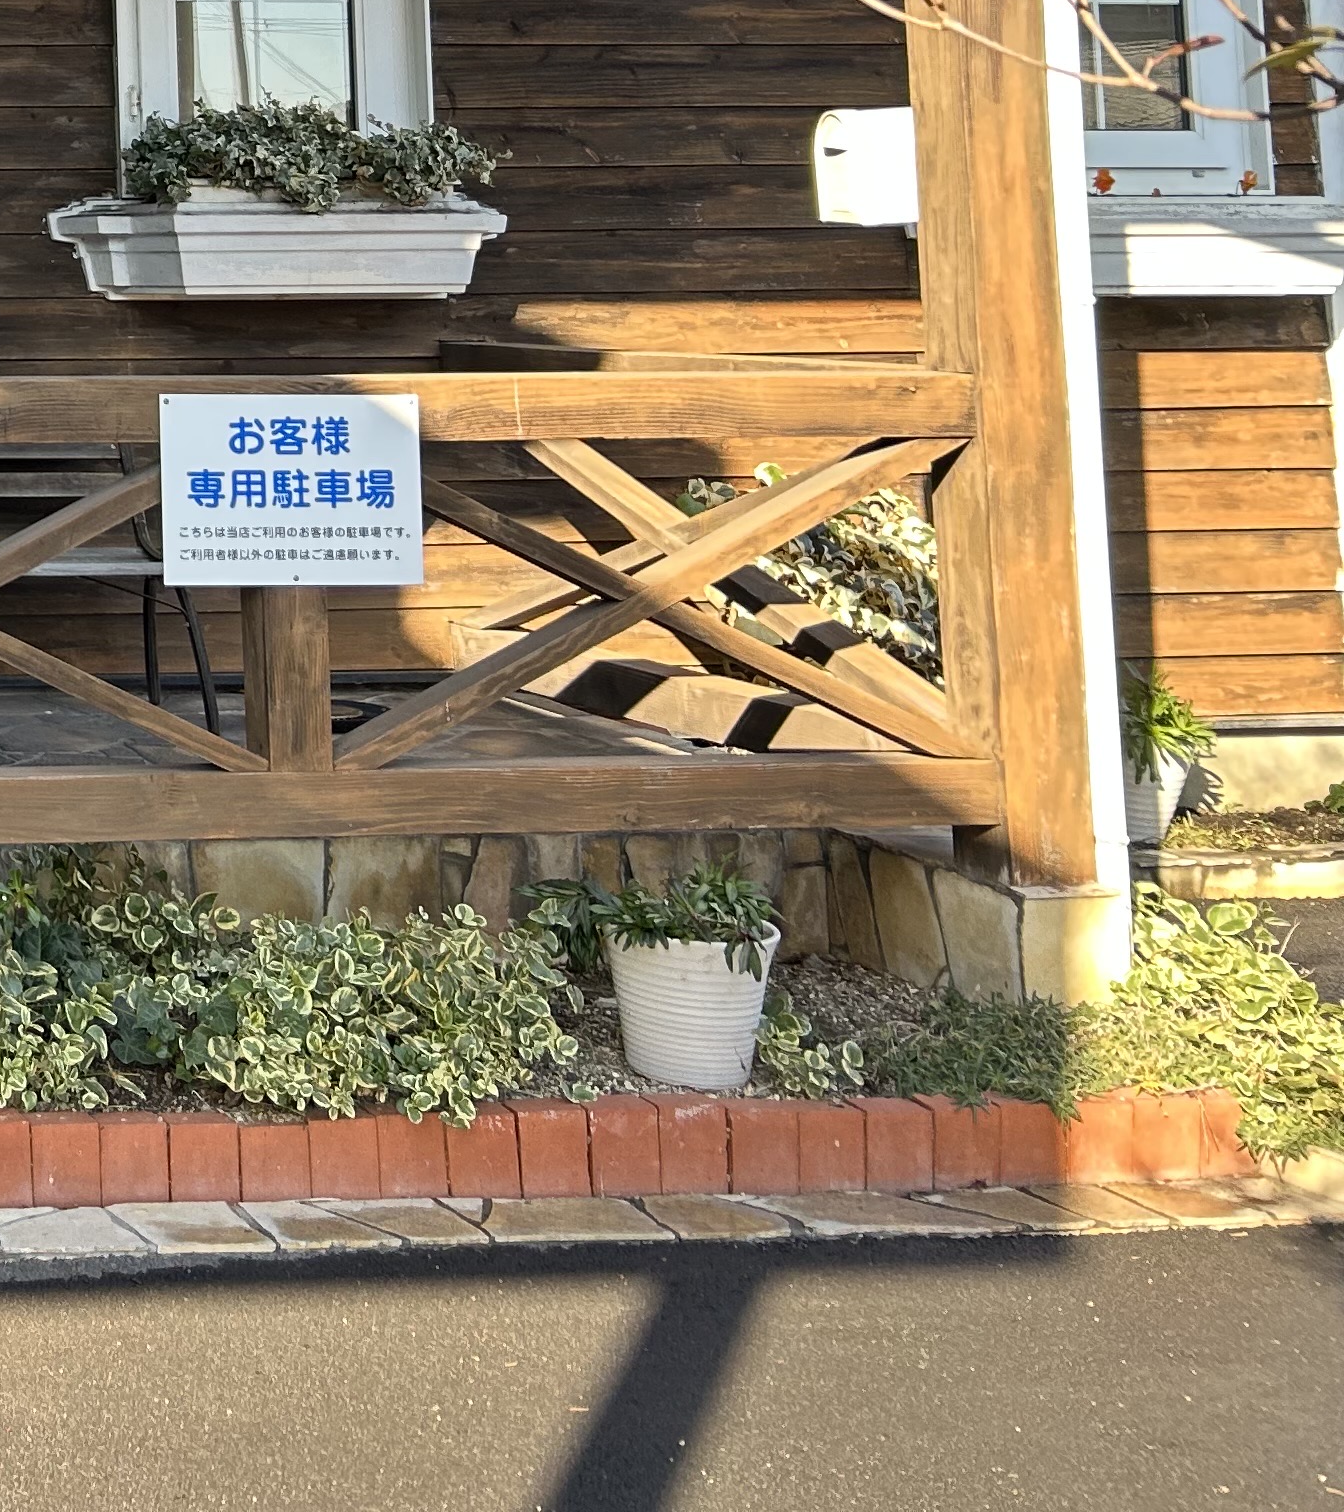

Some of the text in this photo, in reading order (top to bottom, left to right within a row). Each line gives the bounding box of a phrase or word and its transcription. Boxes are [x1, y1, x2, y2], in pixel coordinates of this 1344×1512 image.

[228, 416, 351, 456] お客様
[186, 468, 396, 509] 専用駐車場
[178, 526, 412, 539] こちらは当店ご利用のお客様の駐車場です。
